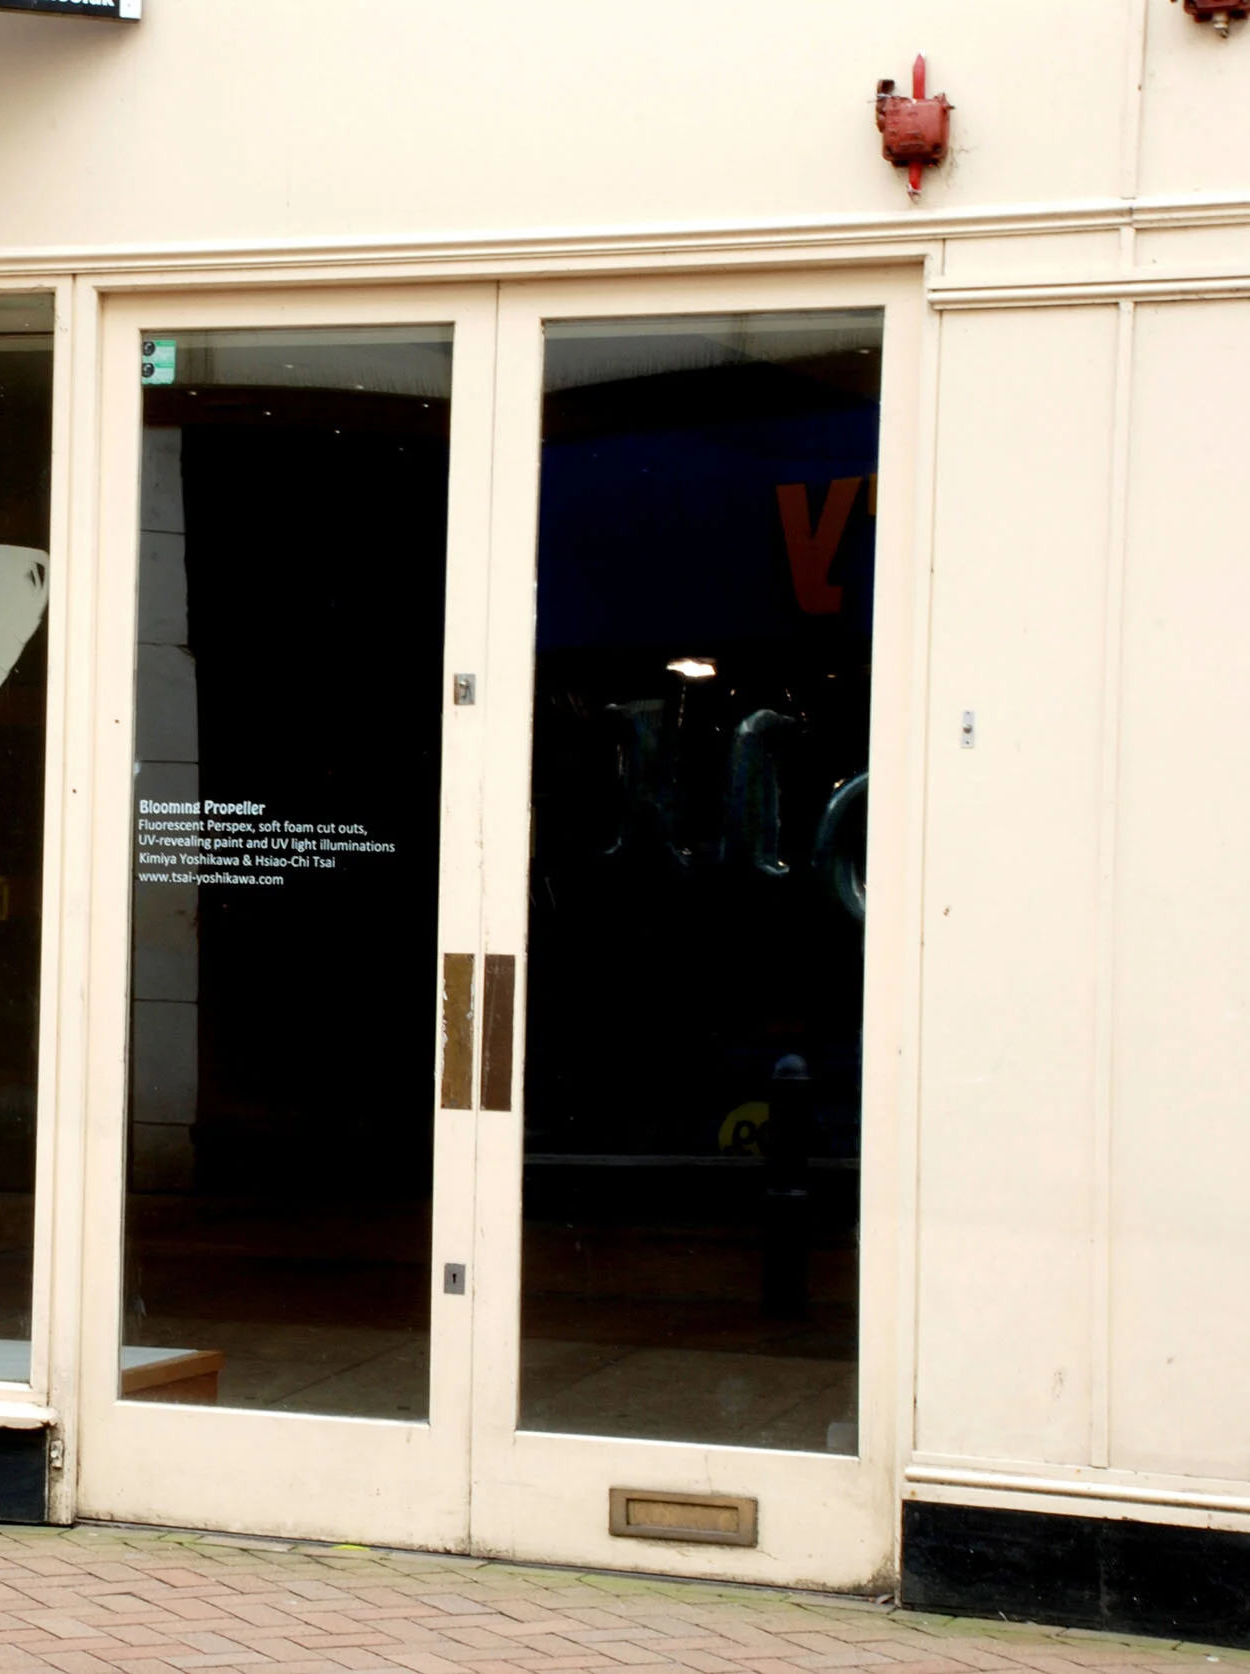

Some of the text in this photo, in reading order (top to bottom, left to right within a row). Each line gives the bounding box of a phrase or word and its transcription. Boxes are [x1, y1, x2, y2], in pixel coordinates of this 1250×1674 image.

[139, 800, 266, 816] Blooming Propeller
[138, 819, 368, 837] Fluorescent Perspex, soft foam cut outs,
[138, 834, 396, 853] UV-revealing paint and UV light illuminations
[138, 852, 337, 869] Kimiya Yoshikawa & Hsiao-Chi Tsai
[138, 871, 285, 886] www.tsai-yoshikawa.com
